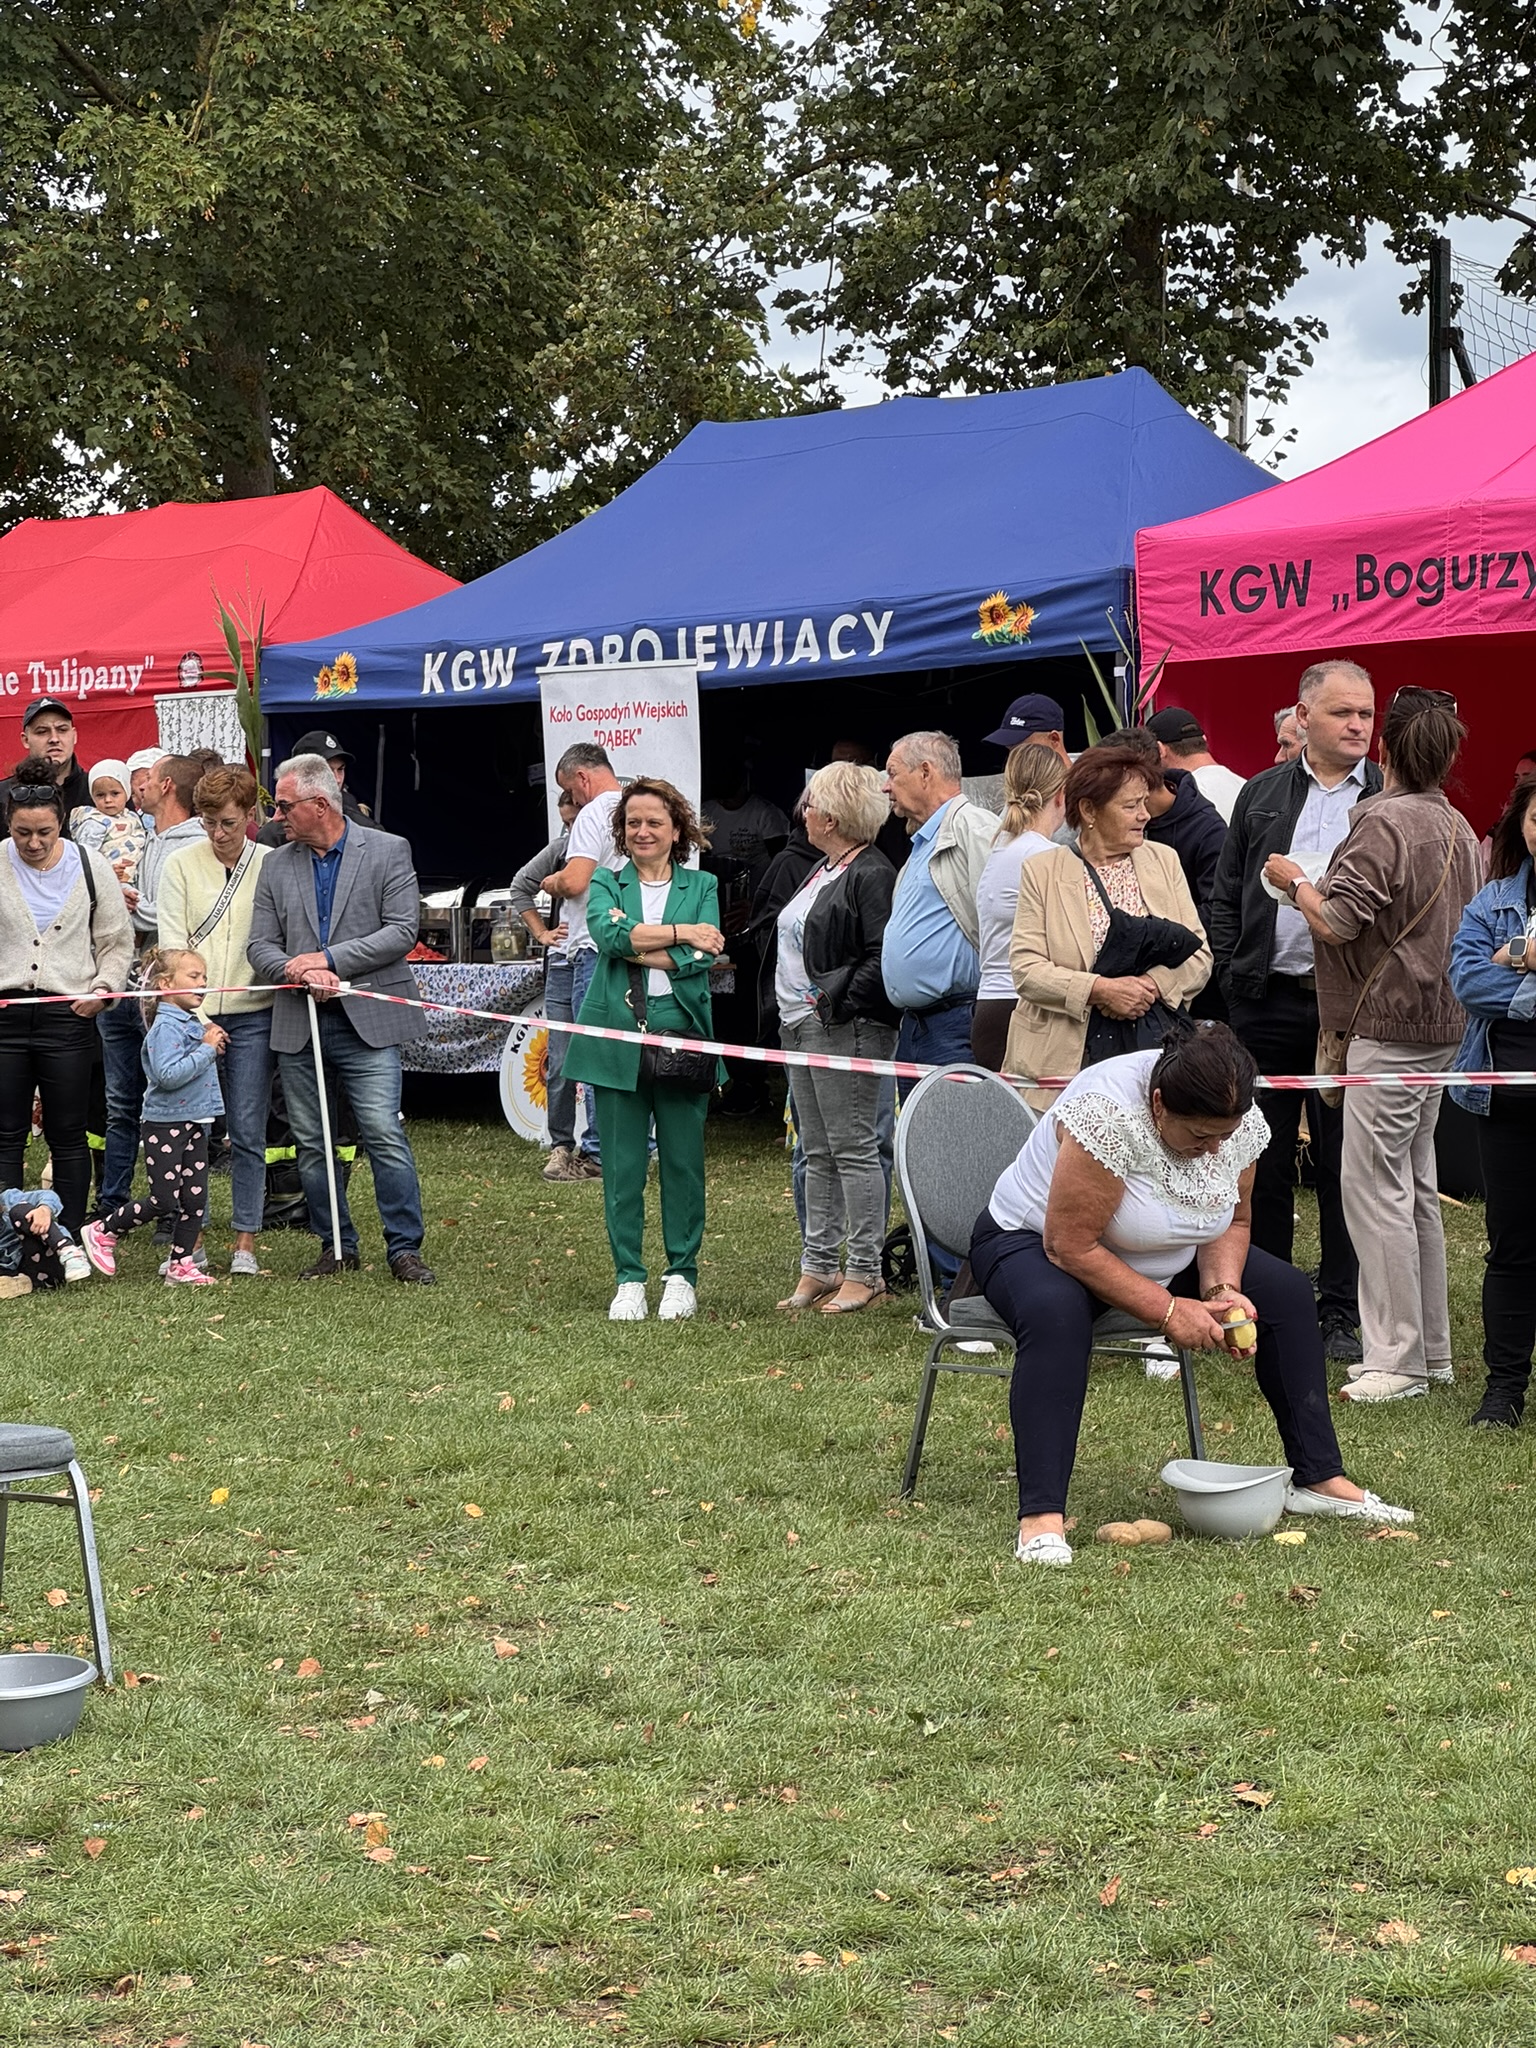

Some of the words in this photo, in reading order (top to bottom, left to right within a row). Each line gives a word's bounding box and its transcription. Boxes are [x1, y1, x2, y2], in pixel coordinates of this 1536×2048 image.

[1200, 559, 1312, 617] KGW
[27, 655, 155, 700] Tulipany"
[421, 647, 518, 695] KGW
[550, 704, 573, 723] Koło
[576, 700, 631, 725] Gospodyń
[633, 700, 688, 723] Wiejskich
[594, 728, 642, 751] "DĄBEK"
